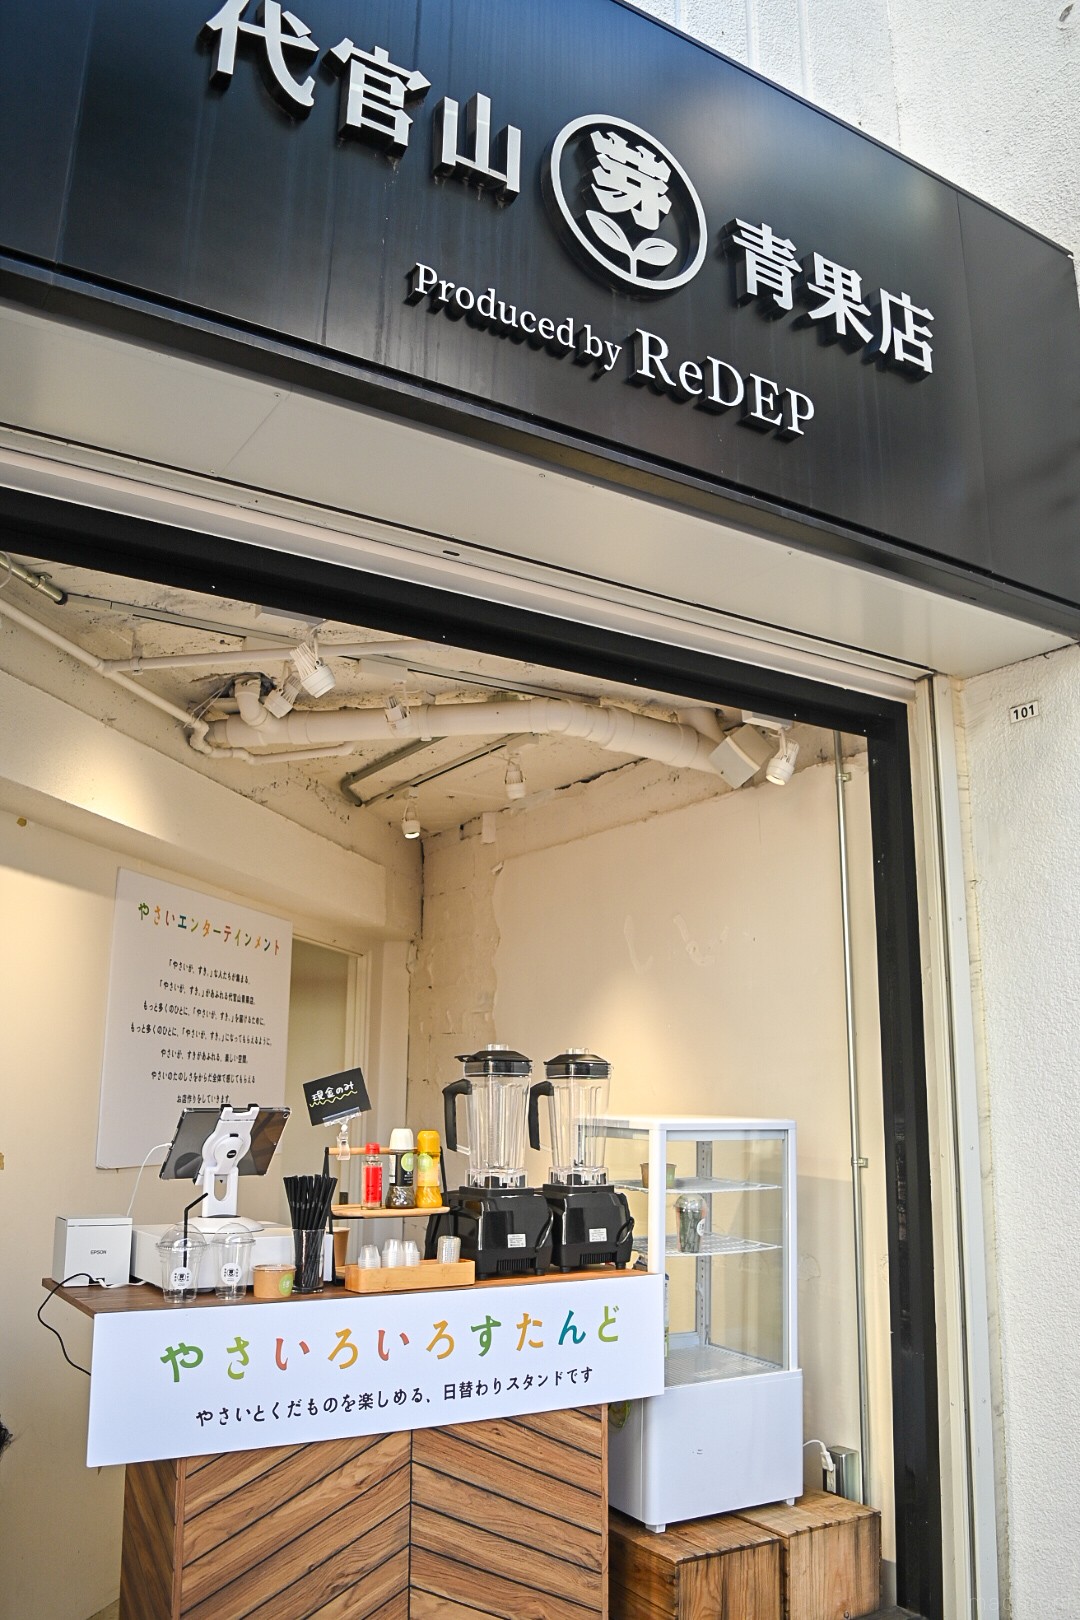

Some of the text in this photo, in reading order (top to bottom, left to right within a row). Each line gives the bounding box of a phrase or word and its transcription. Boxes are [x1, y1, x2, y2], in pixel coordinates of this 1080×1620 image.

[204, 0, 935, 374] 代官山 芽 青果店
[414, 262, 815, 435] Produced by ReDEP
[1013, 704, 1035, 720] 101
[138, 902, 280, 956] やさいエンターテインメント
[311, 1081, 355, 1102] 現金のみ
[160, 1304, 621, 1384] やさいろいろすたんど
[195, 1366, 594, 1428] やさいとくだものを楽しめる、日替わりスタンドです
